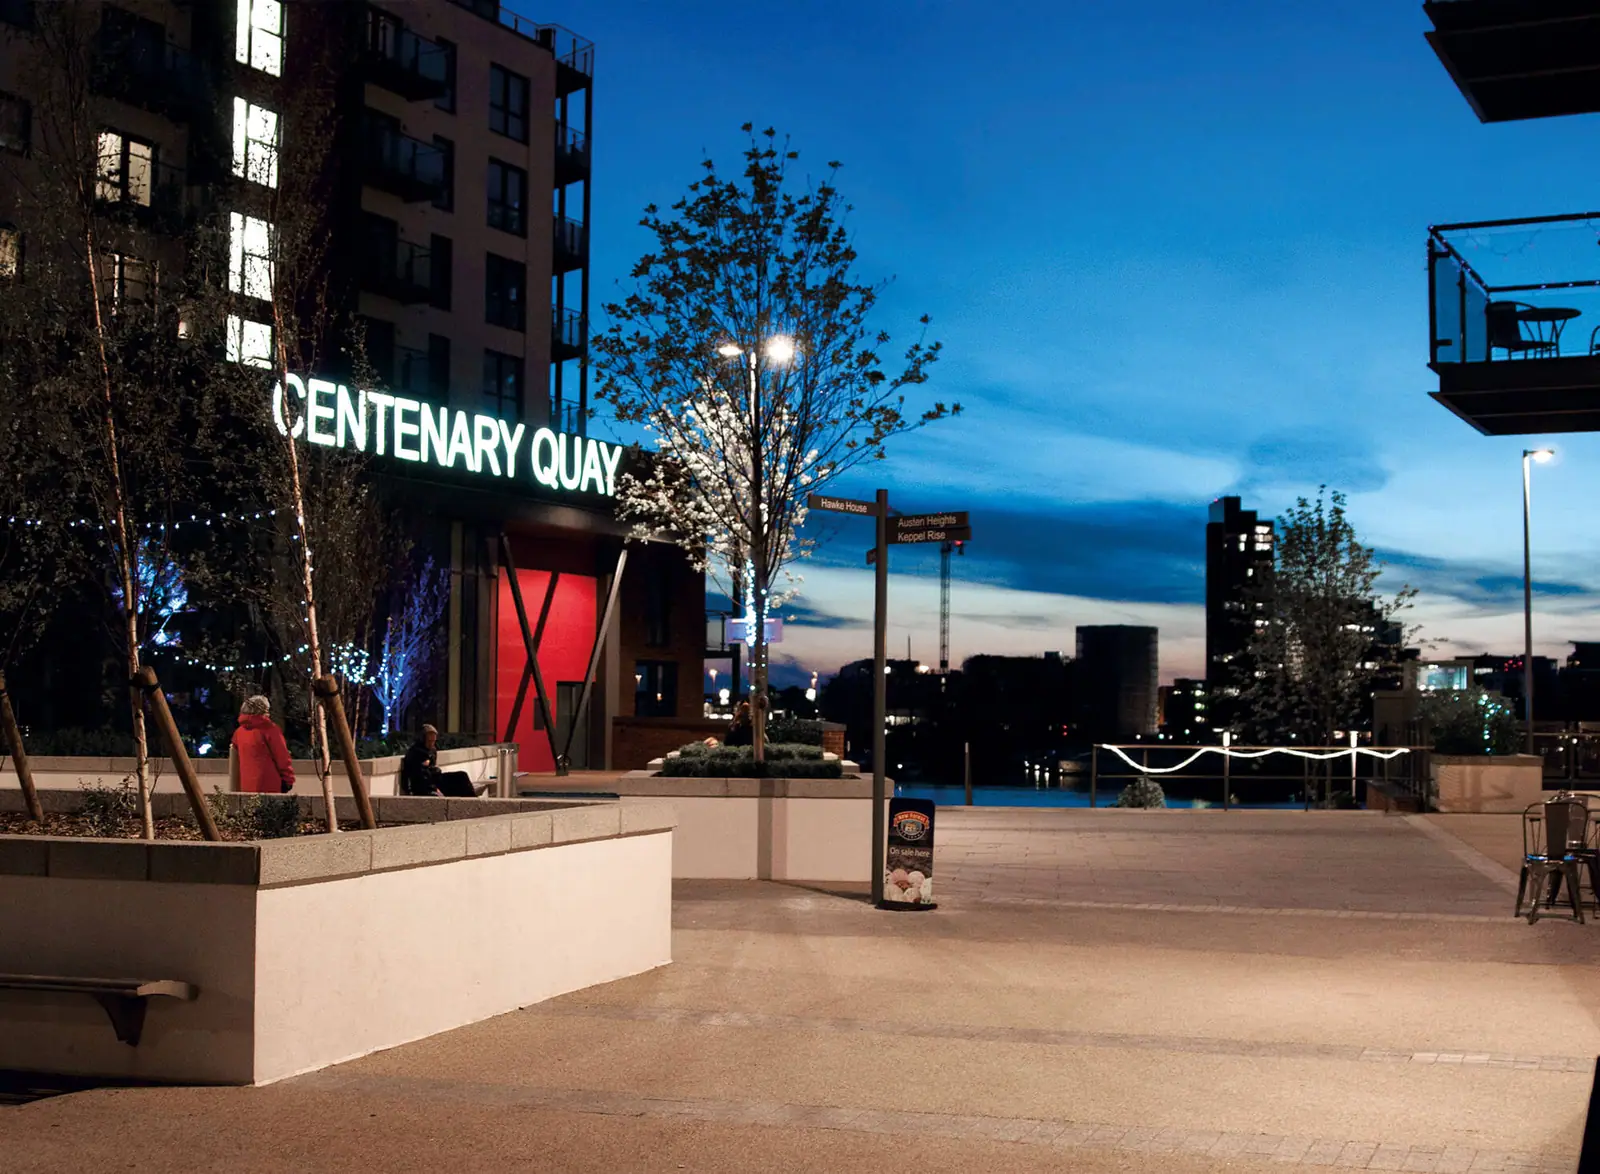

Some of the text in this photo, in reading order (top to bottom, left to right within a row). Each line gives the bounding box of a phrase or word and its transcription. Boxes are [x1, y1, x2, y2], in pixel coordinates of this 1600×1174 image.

[272, 373, 623, 497] CENTENARY QUAY
[820, 498, 868, 513] Hawke House
[897, 515, 957, 528] Austen Heights
[897, 530, 946, 543] Keppel Rise
[890, 847, 931, 858] On sale here
